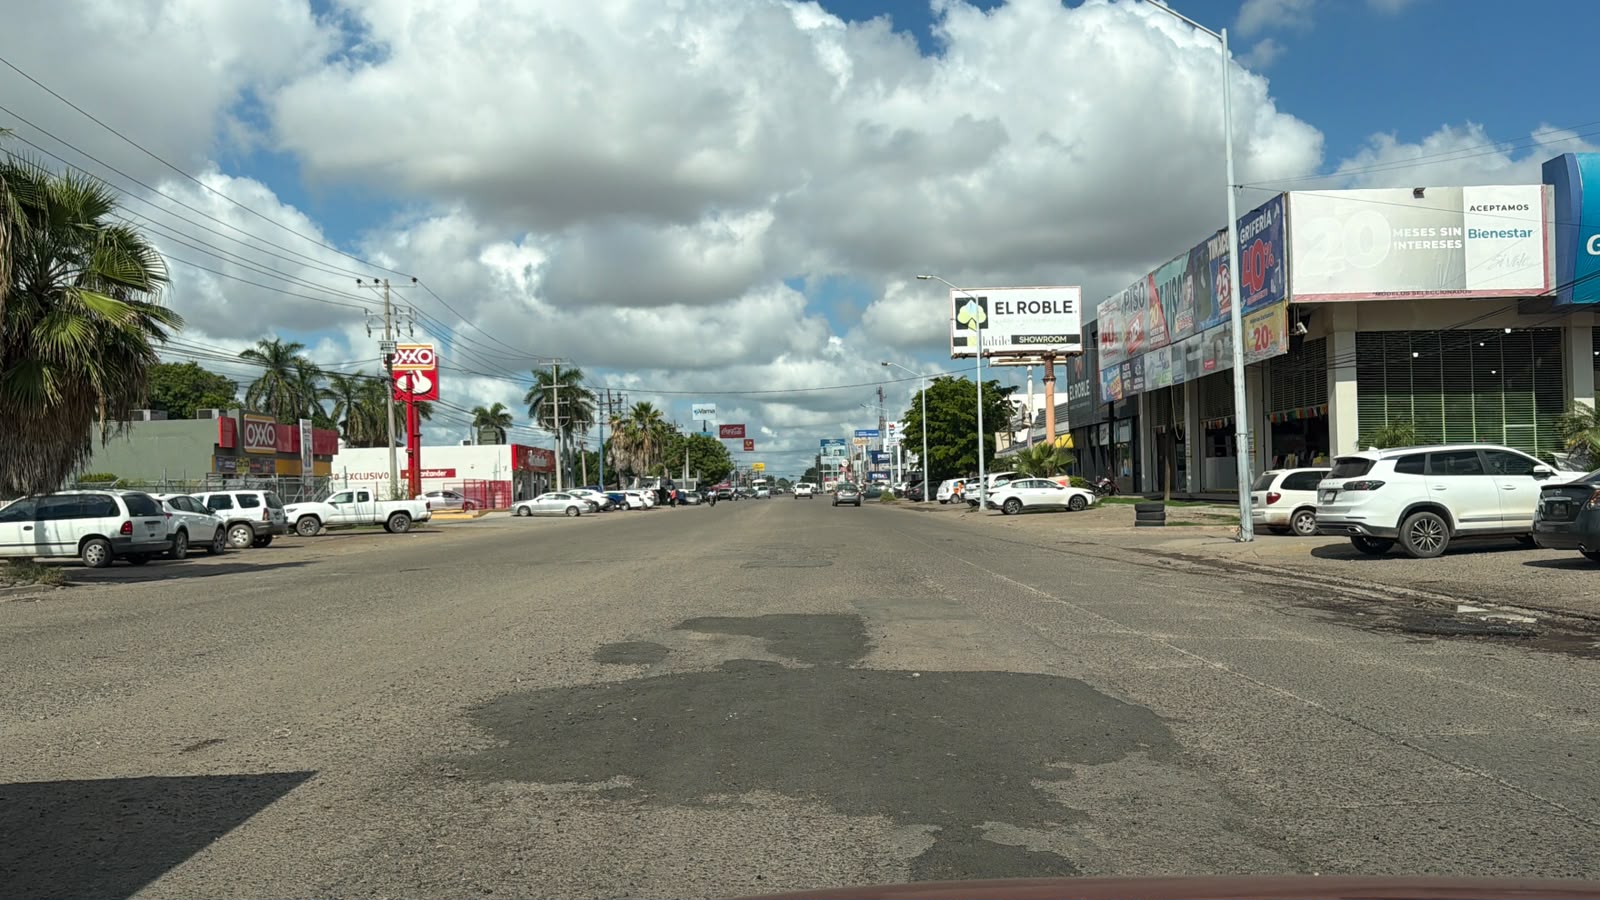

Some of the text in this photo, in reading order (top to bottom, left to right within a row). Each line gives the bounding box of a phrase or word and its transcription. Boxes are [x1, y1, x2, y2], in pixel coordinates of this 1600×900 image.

[1469, 203, 1530, 212] ACEPTAMOS
[1239, 208, 1272, 245] GRIFERÍA
[1392, 226, 1462, 237] MESES SIN
[1467, 227, 1533, 240] Bienestar
[1300, 209, 1392, 277] 20
[1392, 238, 1463, 250] INTERESES
[994, 300, 1073, 315] EL ROBLE
[1018, 335, 1067, 343] SHOWROOM
[382, 348, 433, 365] OXXO
[246, 422, 276, 448] OXXO
[346, 472, 390, 481] EXCLUSIVO
[419, 469, 448, 477] antander
